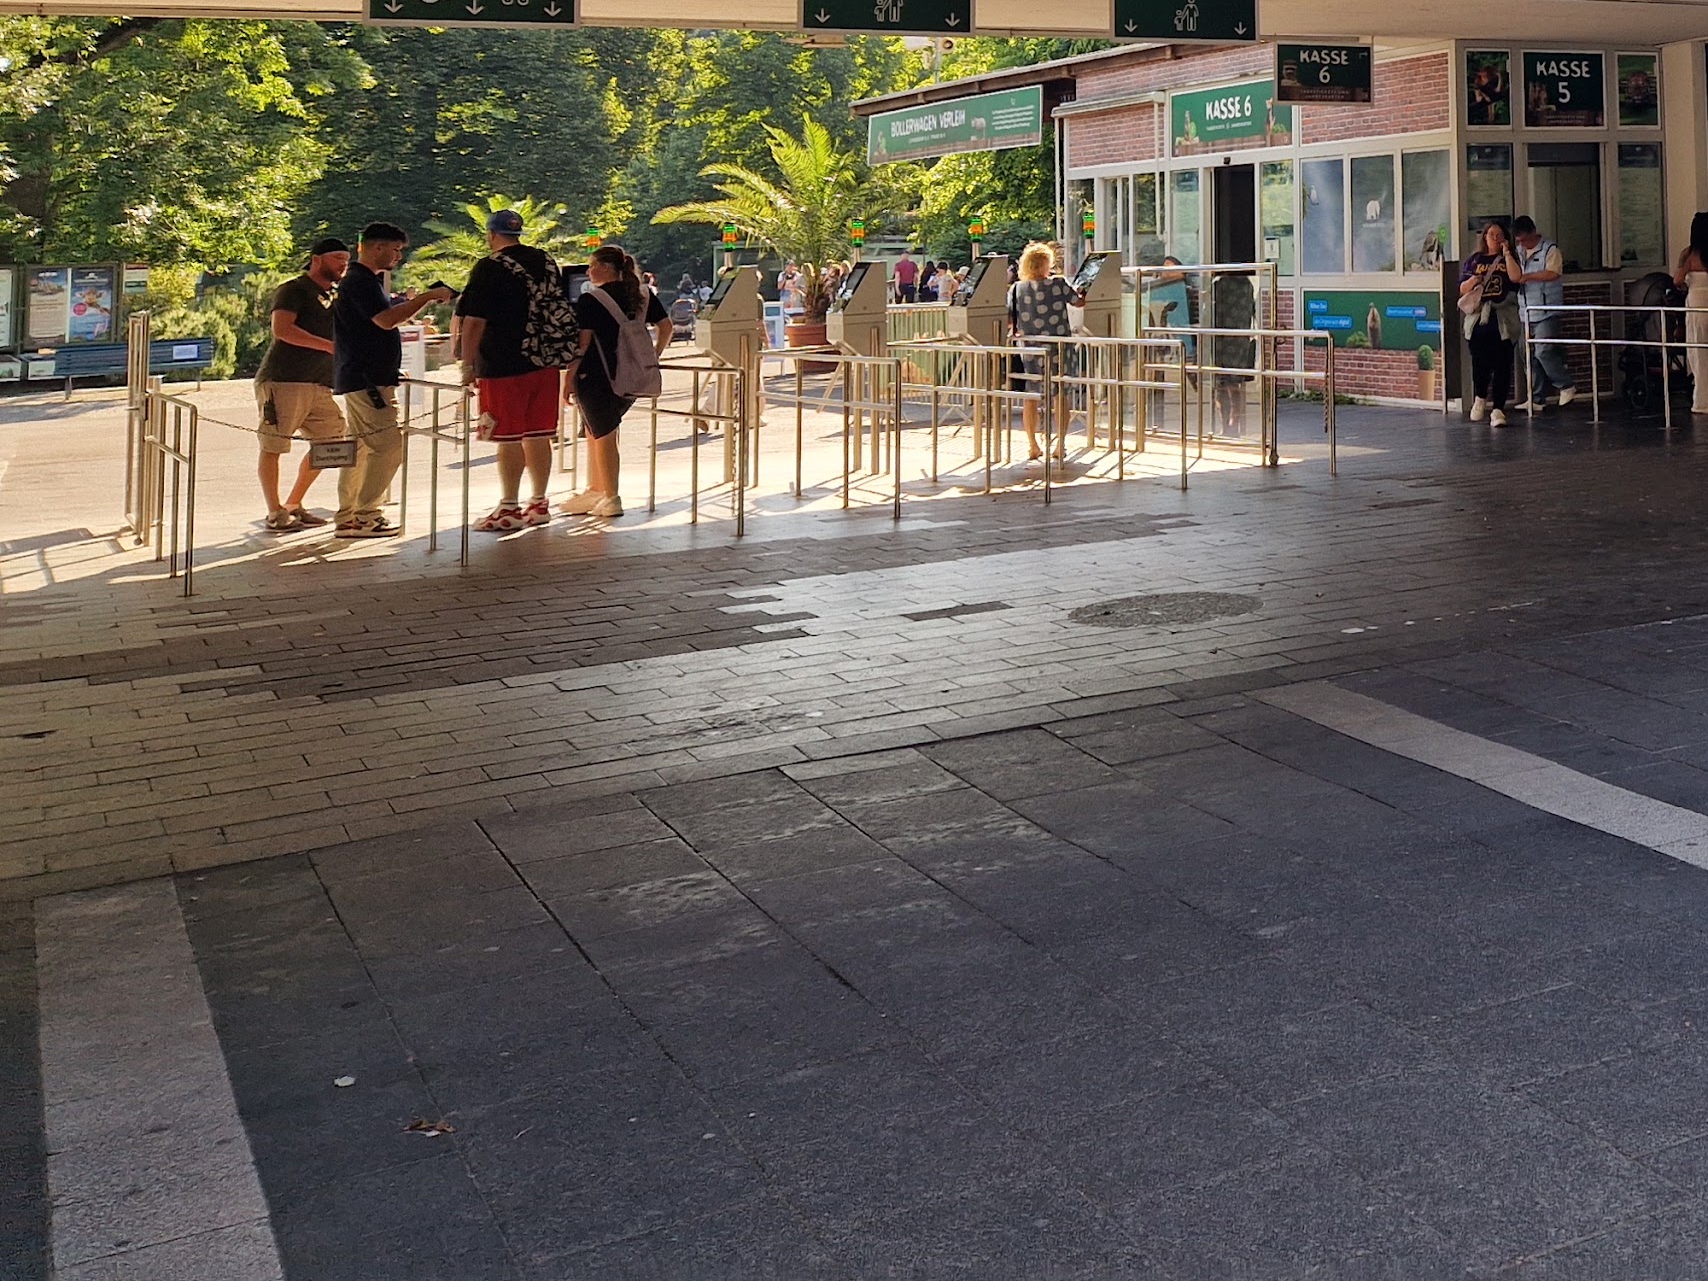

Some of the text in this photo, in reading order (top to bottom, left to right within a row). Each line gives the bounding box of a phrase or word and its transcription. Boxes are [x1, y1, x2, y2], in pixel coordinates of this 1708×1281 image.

[1299, 49, 1349, 65] KASSE
[1318, 66, 1331, 84] 6
[1536, 60, 1591, 78] KASSE
[1558, 81, 1571, 104] 5
[1205, 94, 1253, 121] KASSE 6
[890, 114, 937, 138] BOLLERWAGEN
[939, 109, 966, 129] VERLEIH
